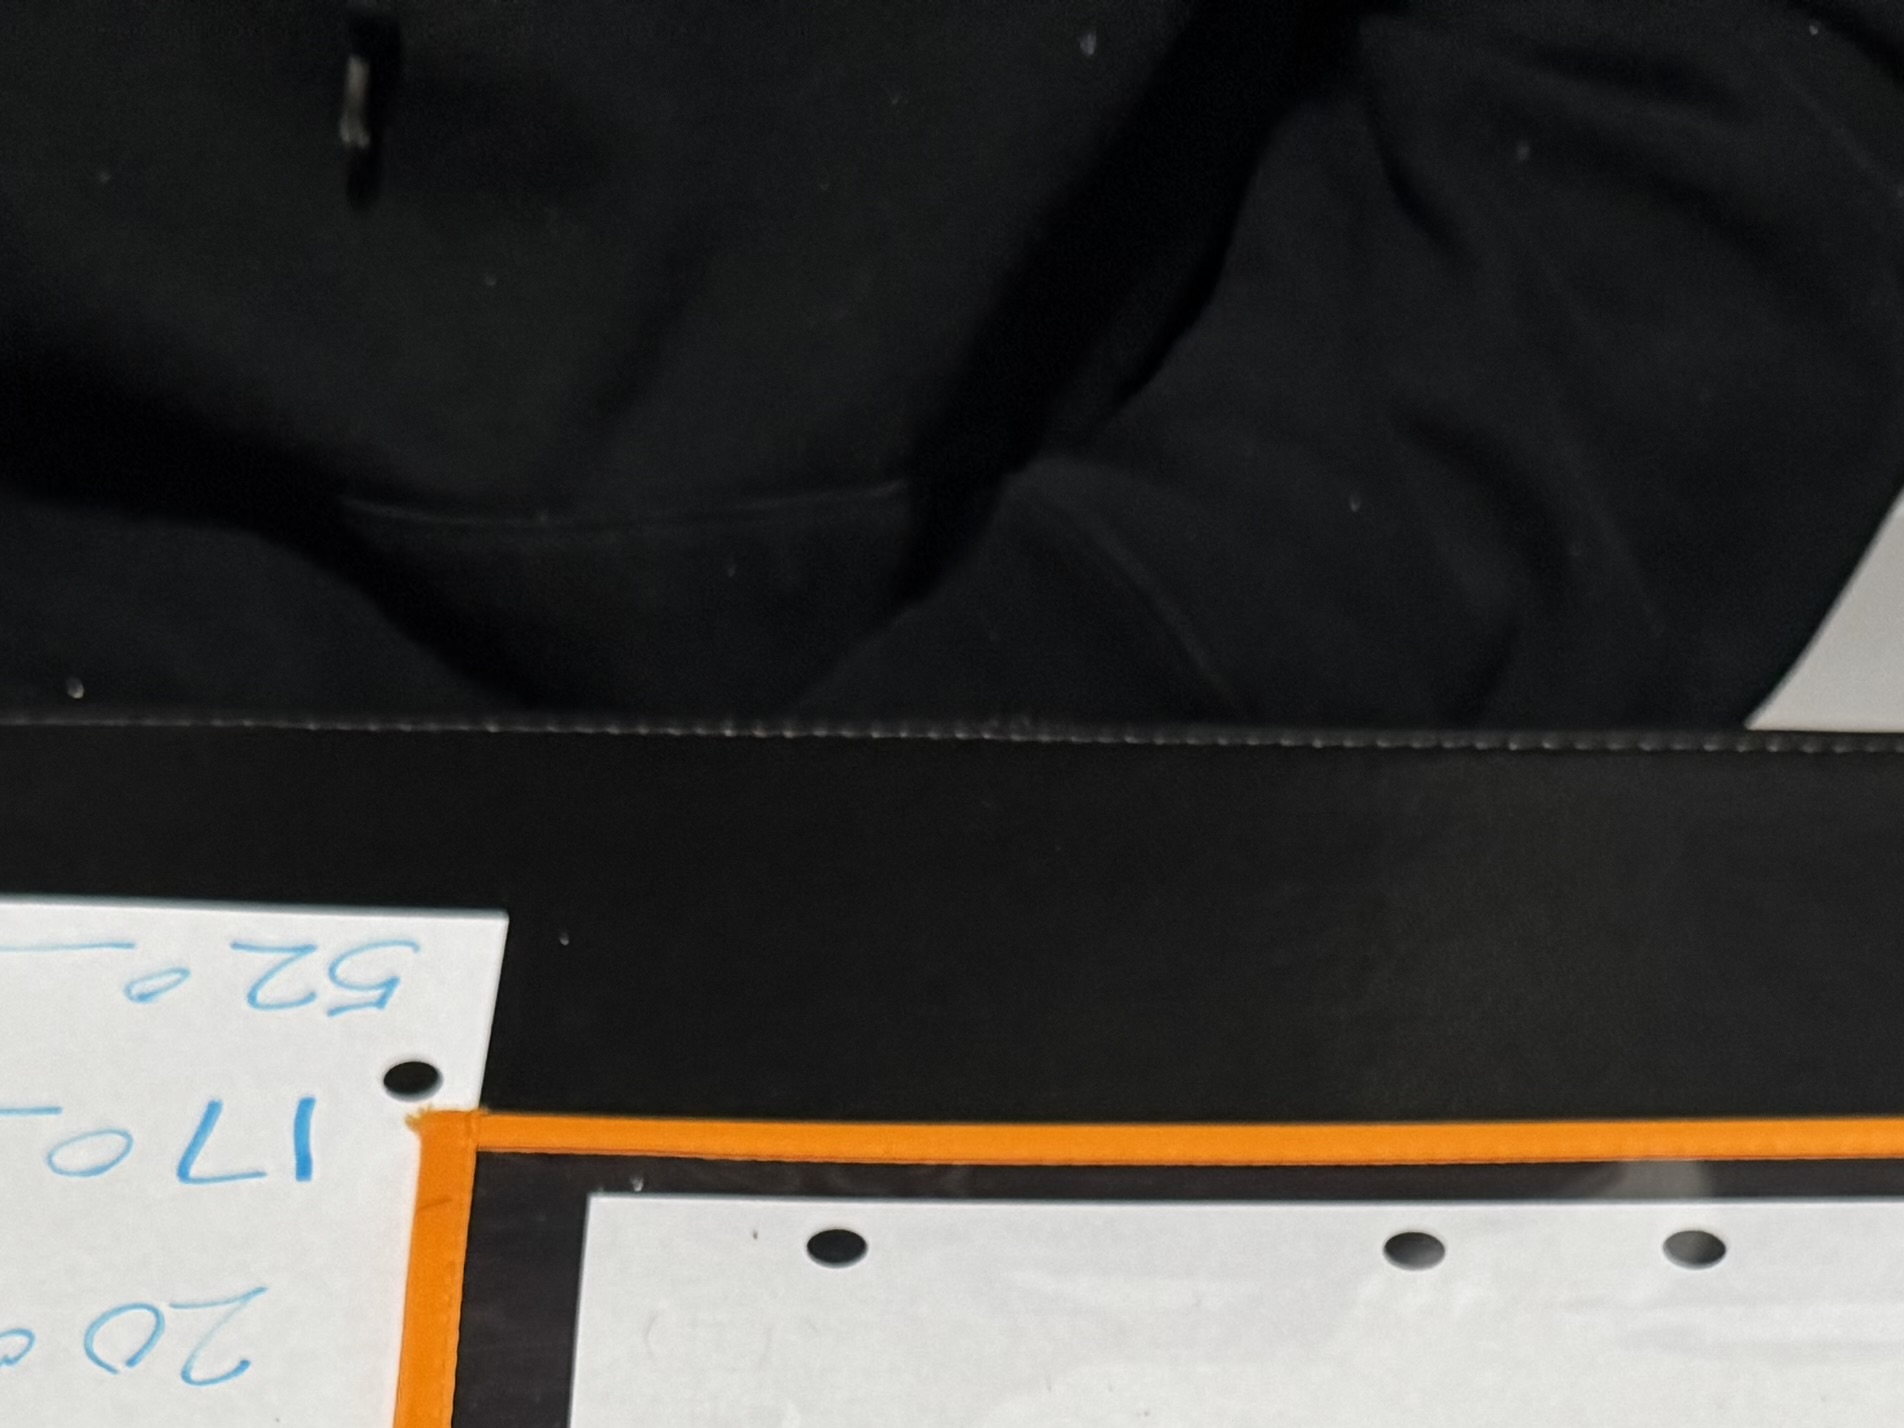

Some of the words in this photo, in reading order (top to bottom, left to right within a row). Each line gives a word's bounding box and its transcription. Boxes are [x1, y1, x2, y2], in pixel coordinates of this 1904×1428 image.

[230, 939, 420, 1017] 52
[177, 1097, 316, 1184] 17
[83, 1288, 263, 1387] 20
